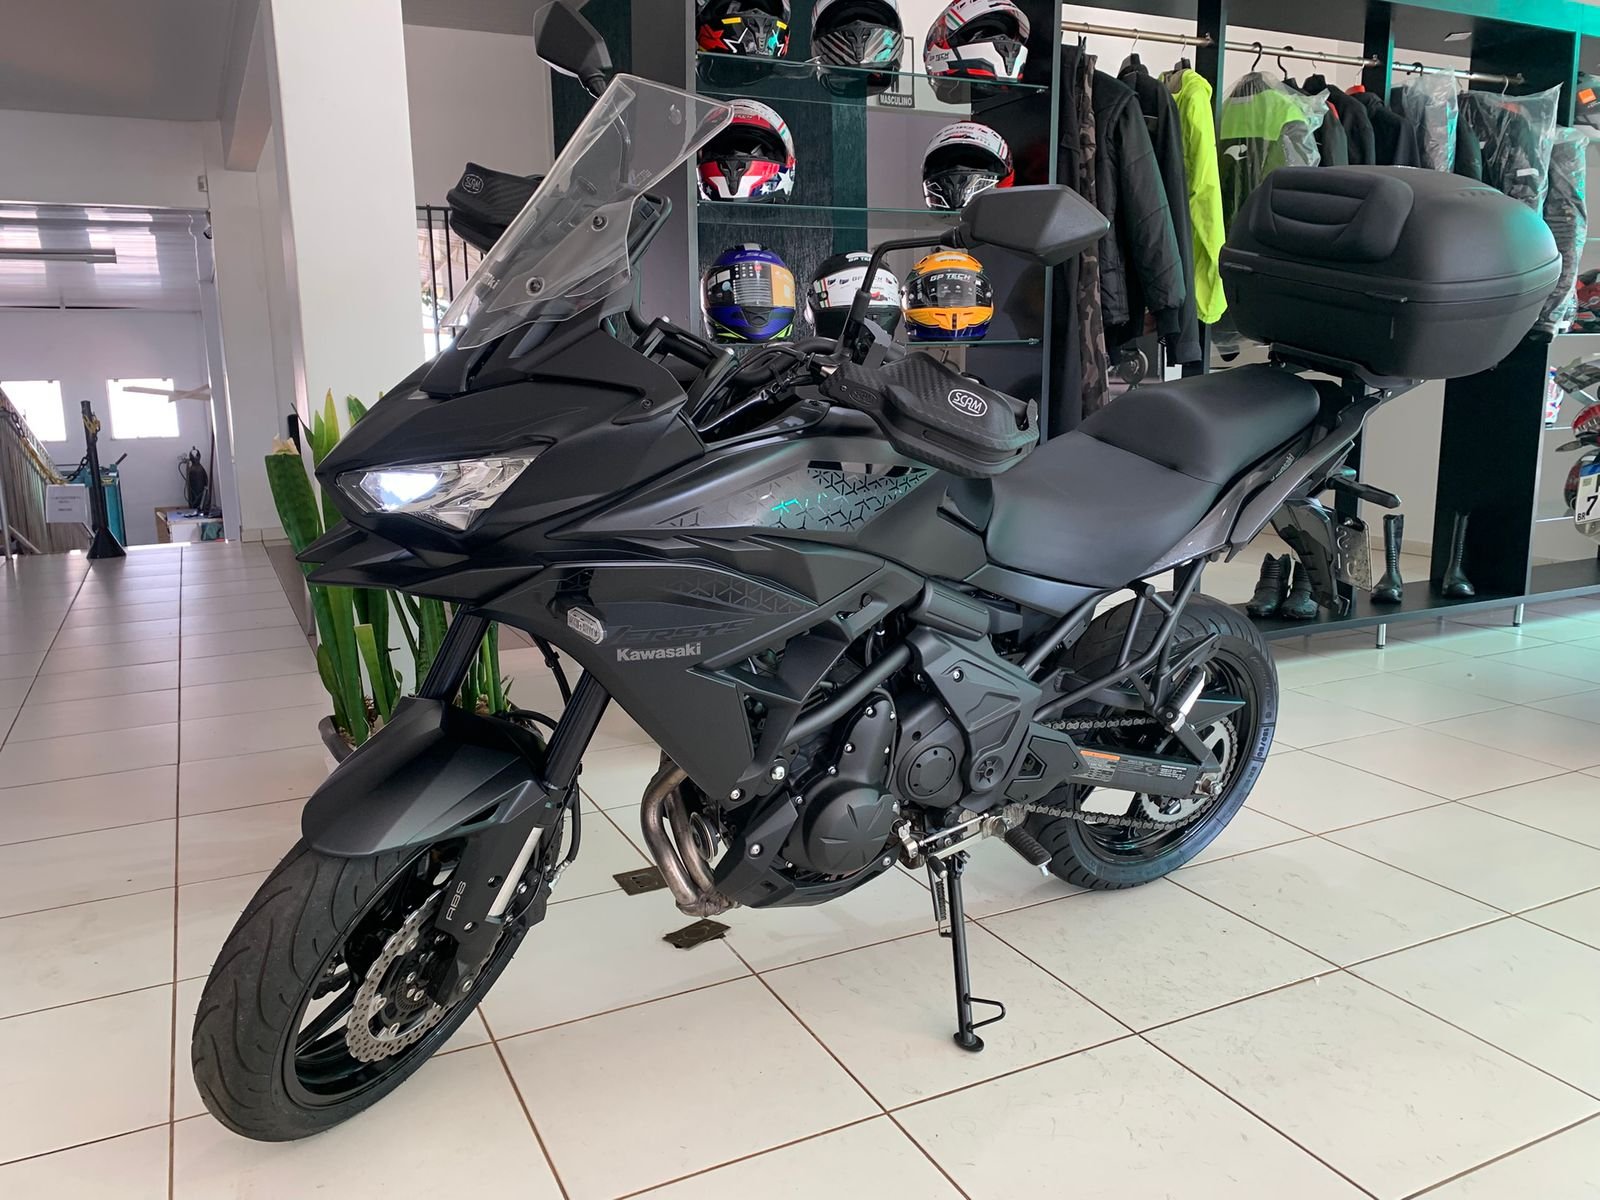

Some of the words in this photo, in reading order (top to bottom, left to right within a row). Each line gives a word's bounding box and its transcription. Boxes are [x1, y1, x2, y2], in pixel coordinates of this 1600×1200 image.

[880, 94, 913, 106] MASCULINO
[929, 274, 945, 282] GP
[946, 273, 972, 282] TECH
[951, 391, 983, 414] SCAM
[1577, 512, 1586, 521] BR
[616, 641, 702, 662] Kawasaki
[445, 881, 467, 921] ABS
